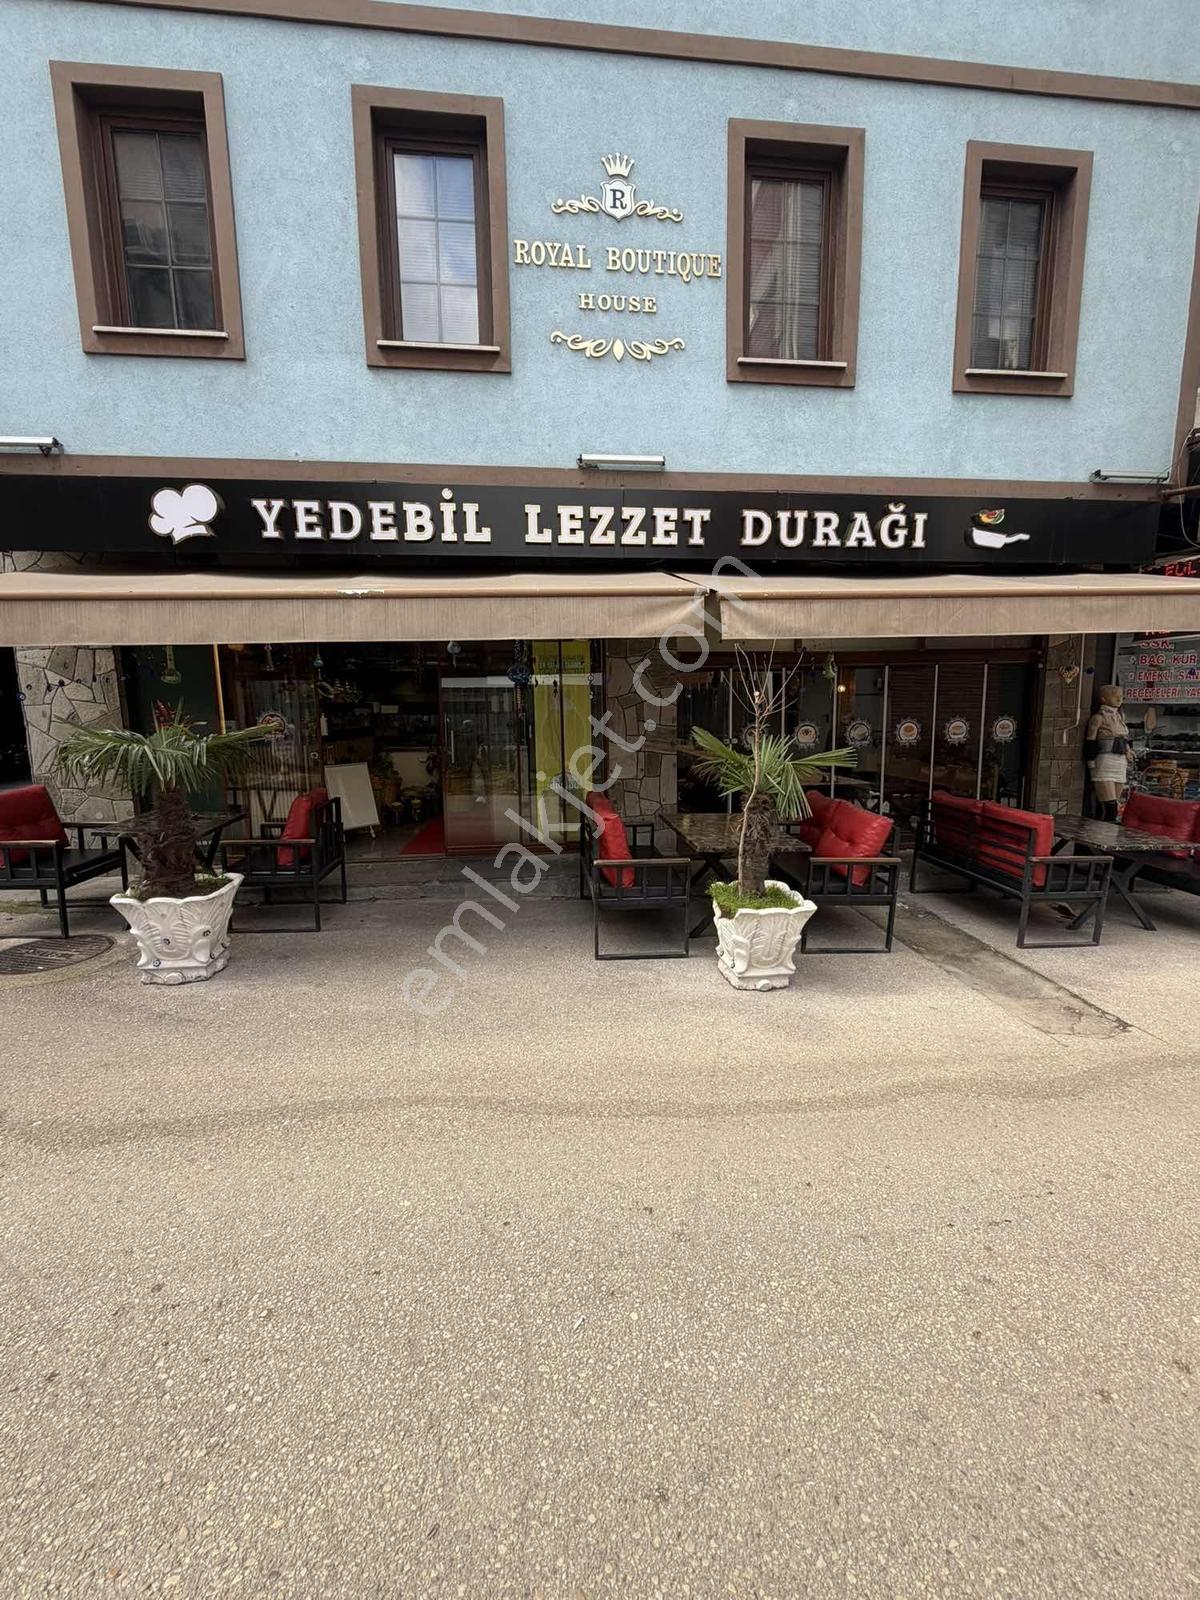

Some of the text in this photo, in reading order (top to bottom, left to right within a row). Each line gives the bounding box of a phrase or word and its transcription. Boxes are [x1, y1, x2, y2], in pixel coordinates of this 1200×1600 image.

[609, 189, 627, 210] R
[514, 239, 722, 282] ROYAL BOUTIQUE
[578, 293, 657, 313] HOUSE
[251, 487, 929, 549] YEDEBİL LEZZET DURAĞI
